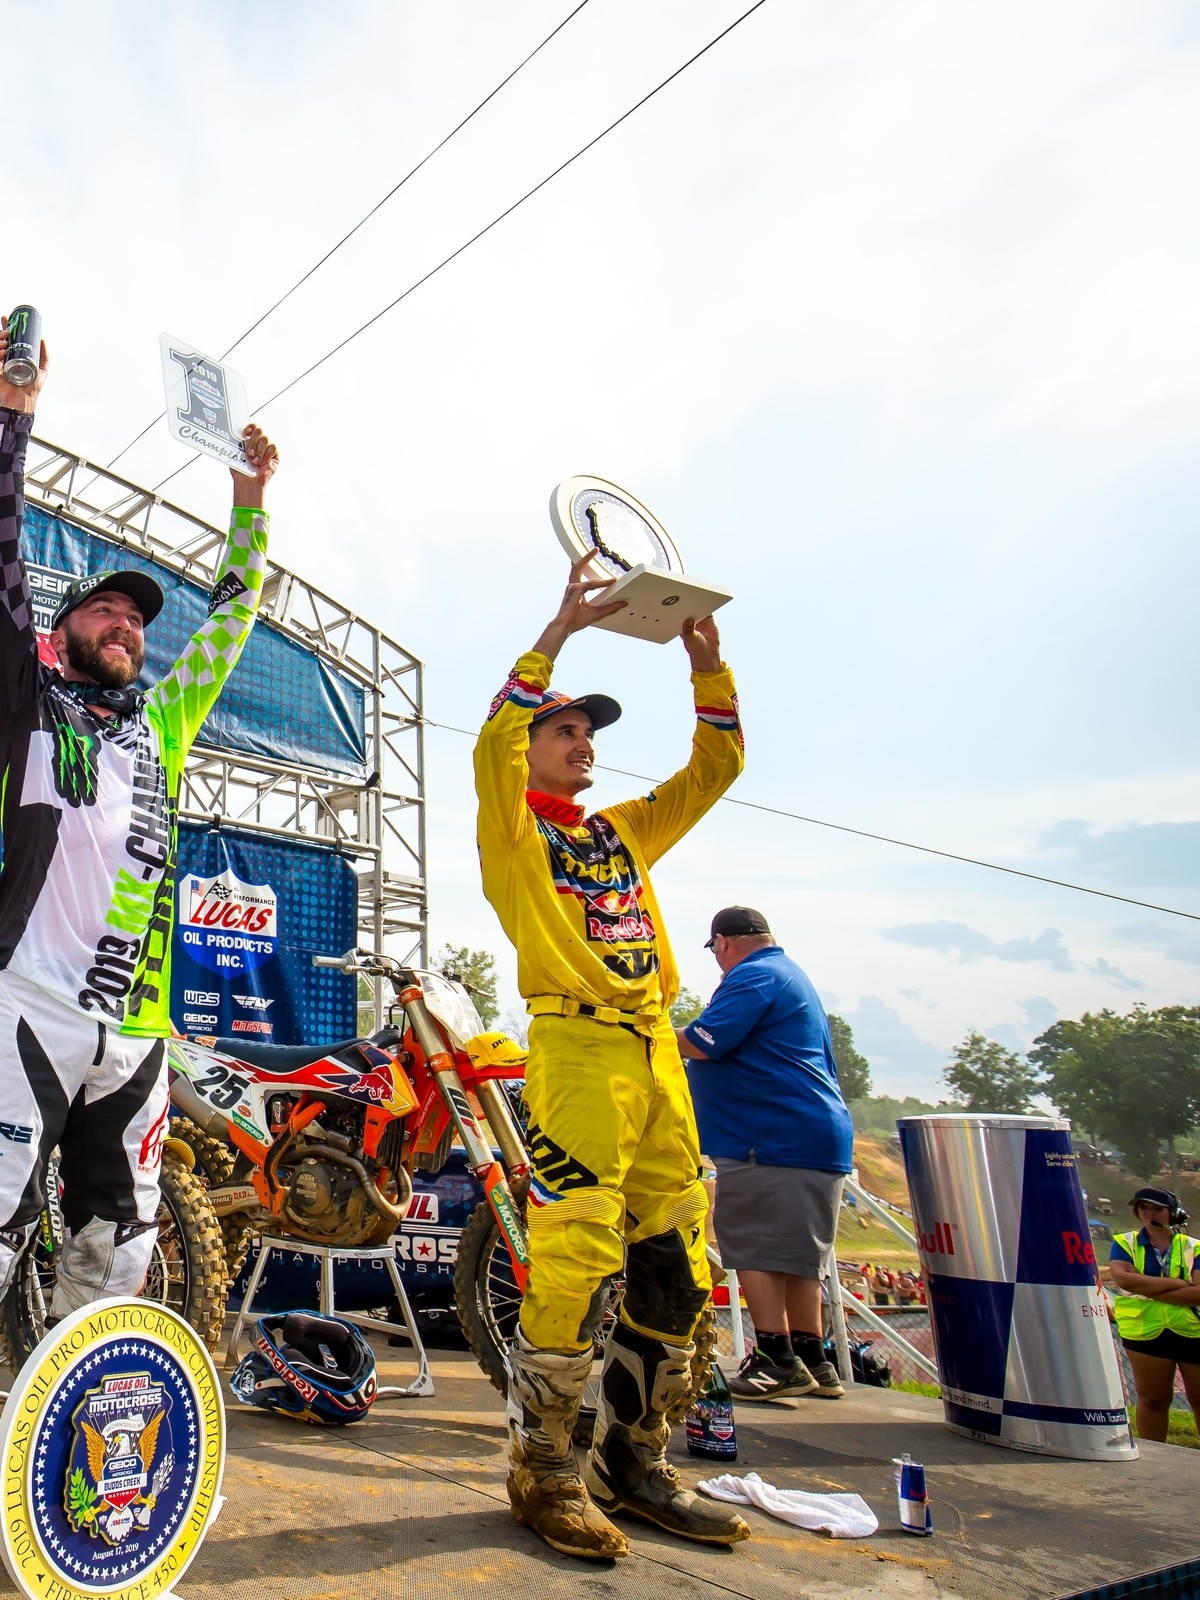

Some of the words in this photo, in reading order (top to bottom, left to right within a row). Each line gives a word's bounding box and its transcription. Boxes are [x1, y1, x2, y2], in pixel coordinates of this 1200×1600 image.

[191, 361, 218, 383] 2019
[190, 900, 273, 933] LUCAS
[183, 931, 203, 946] OIL
[206, 934, 273, 954] PRODUCTS
[216, 954, 244, 968] INC.
[77, 934, 141, 1023] 2019
[184, 990, 220, 1006] WPS
[183, 1013, 218, 1024] GEICO
[192, 1065, 252, 1110] 25
[240, 1120, 264, 1141] MOTOREX
[498, 1203, 528, 1262] MOTOREX
[1061, 1231, 1095, 1265] Re
[89, 1309, 190, 1353] MOTOCROSS
[49, 1331, 86, 1372] PRO
[25, 1378, 53, 1414] OIL
[106, 1379, 132, 1393] LUCAS
[133, 1377, 148, 1389] OIL
[89, 1392, 162, 1414] MOTOCROSS
[967, 1395, 993, 1411] mind.
[1083, 1410, 1103, 1424] With
[188, 1352, 218, 1533] CHAMPIONSHIP
[7, 1421, 31, 1512] LUCAS
[108, 1458, 137, 1471] GEICO
[122, 1476, 141, 1488] CREEK
[107, 1489, 136, 1499] NATIONAL
[9, 1520, 36, 1569] 2019
[92, 1548, 114, 1561] August
[114, 1546, 125, 1556] 17,
[124, 1542, 140, 1555] 2019
[152, 1553, 178, 1589] 450
